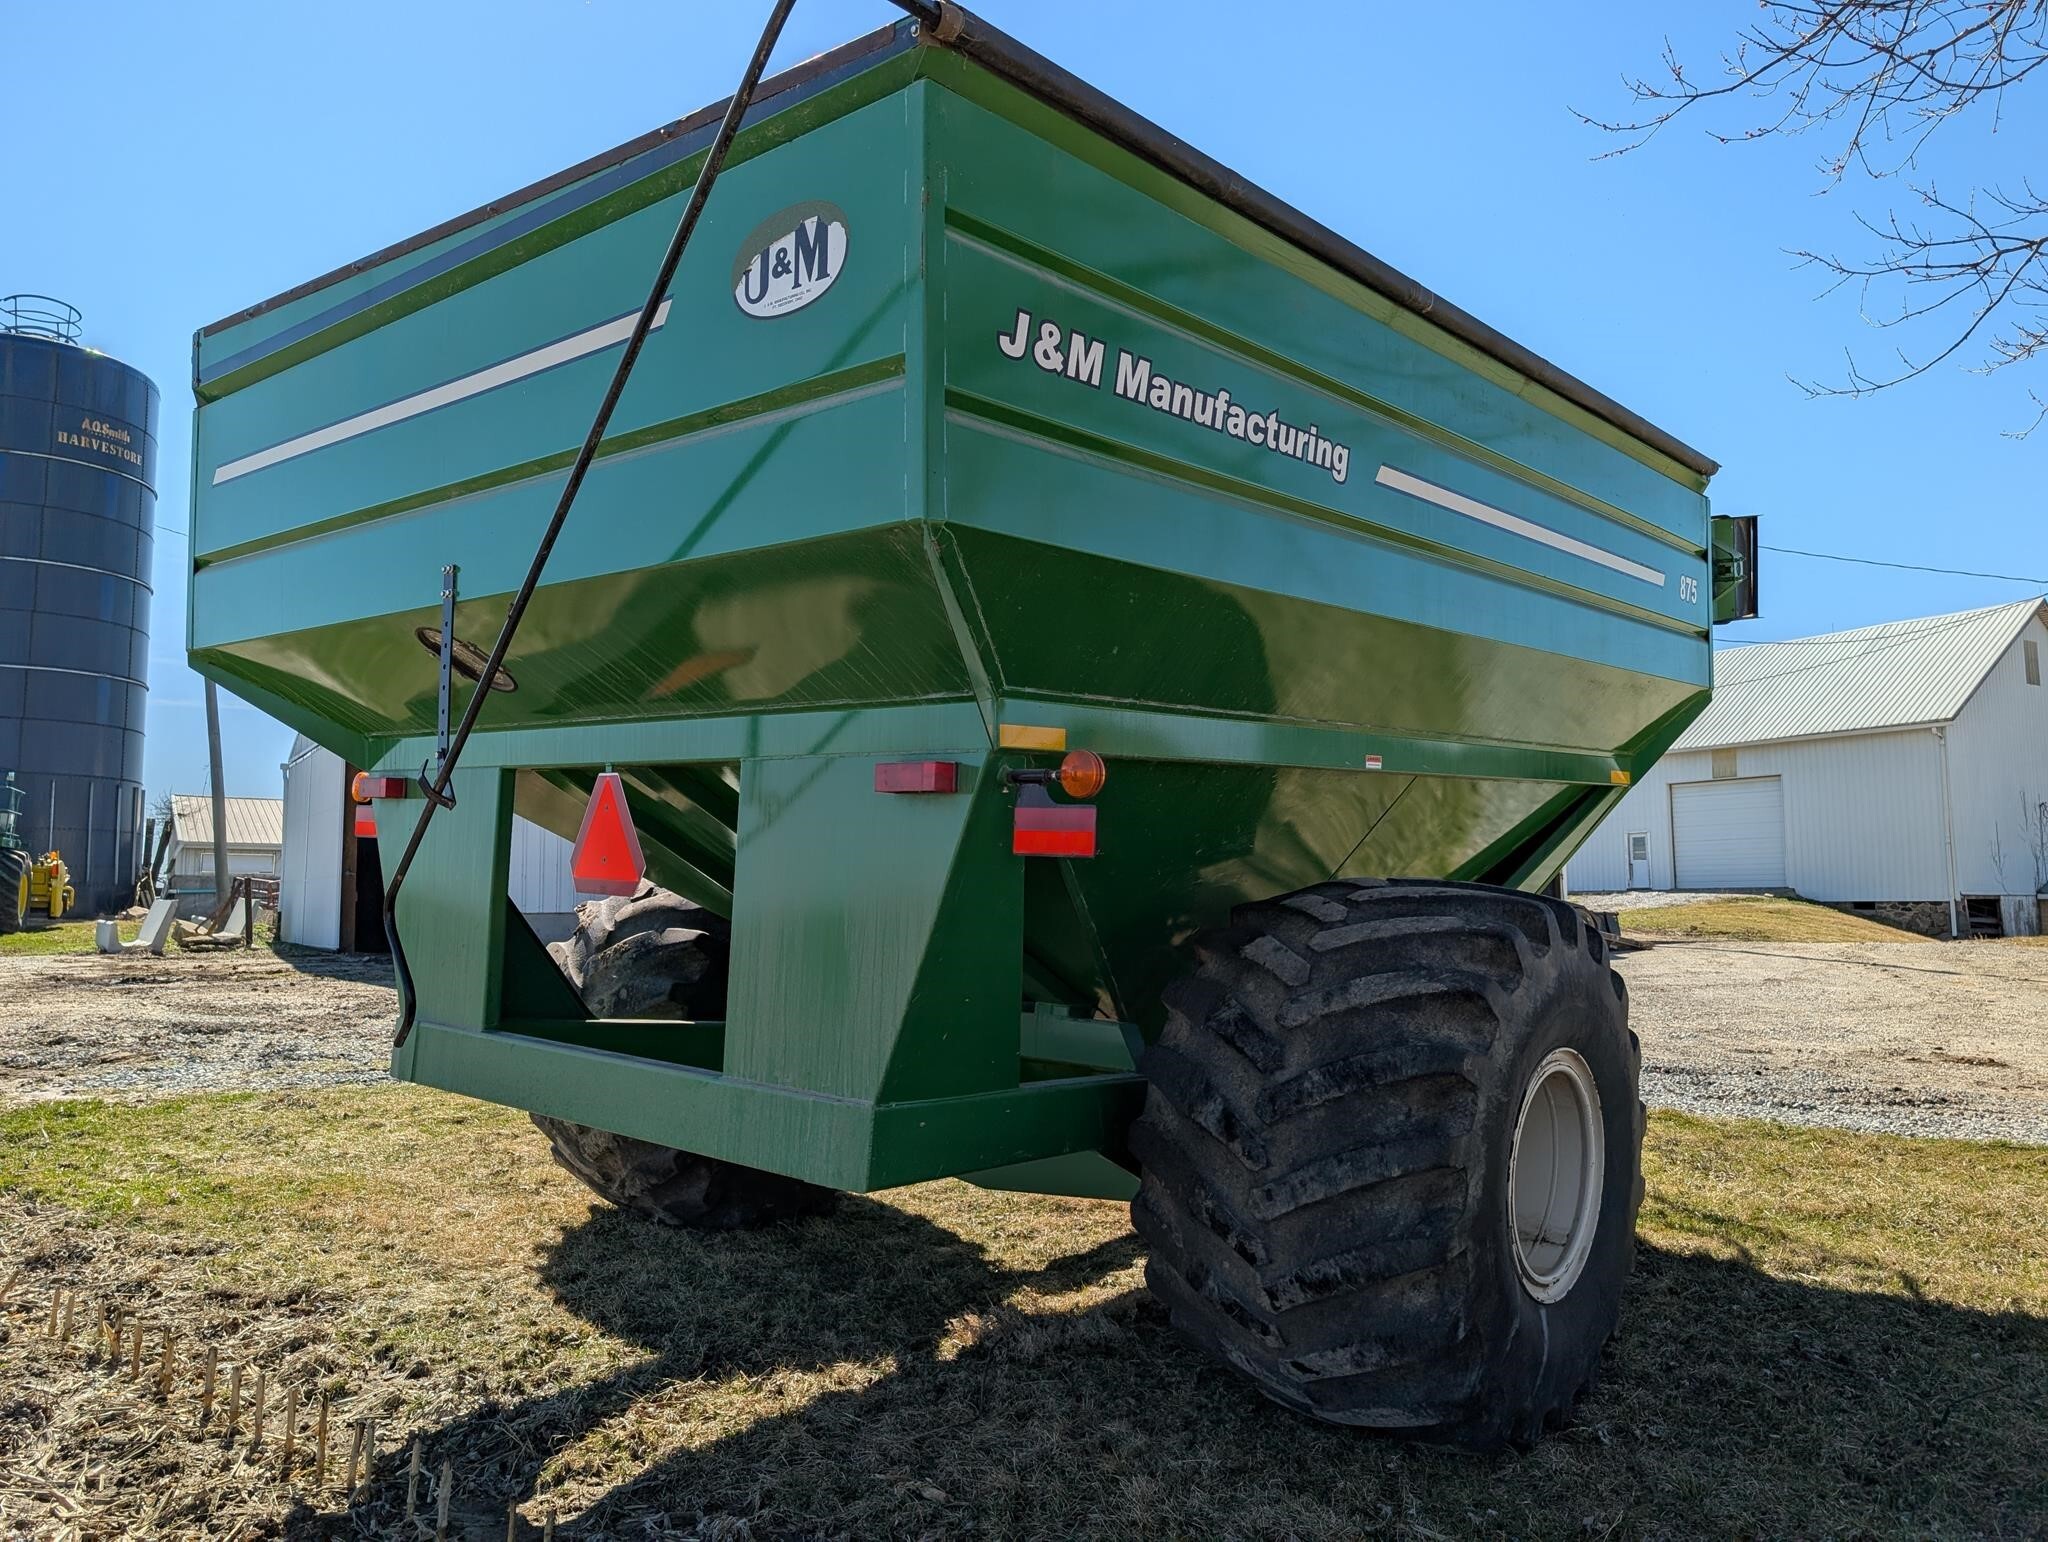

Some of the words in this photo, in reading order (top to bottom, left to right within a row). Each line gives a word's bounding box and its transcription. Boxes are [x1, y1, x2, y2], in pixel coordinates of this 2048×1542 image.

[743, 215, 831, 304] J&M
[997, 308, 1105, 390] J&M
[1113, 348, 1350, 484] Manufacturing
[58, 431, 142, 465] HARVESTORE
[1680, 575, 1697, 604] 875
